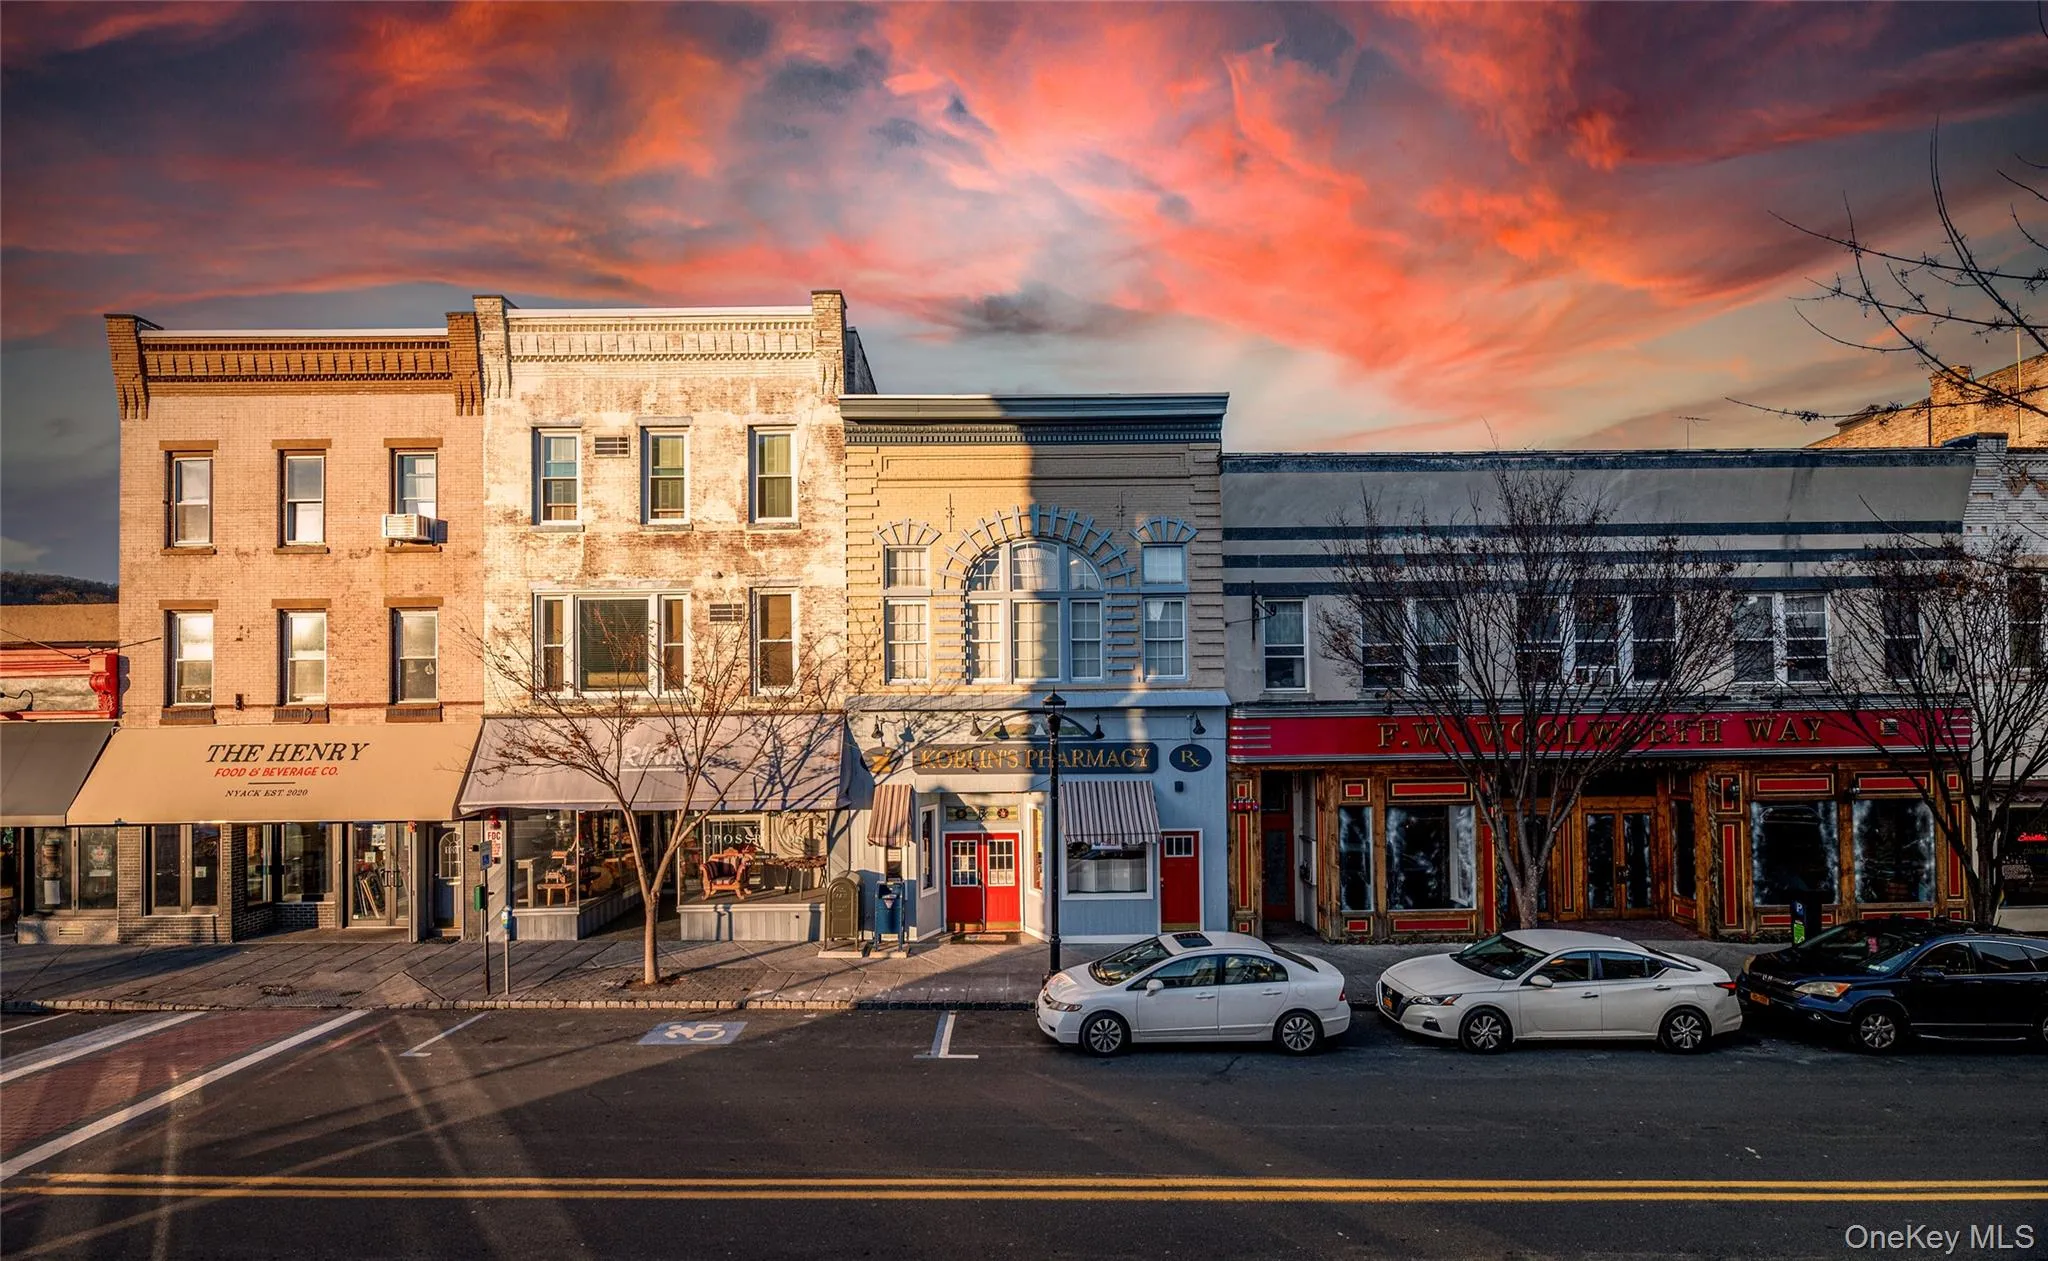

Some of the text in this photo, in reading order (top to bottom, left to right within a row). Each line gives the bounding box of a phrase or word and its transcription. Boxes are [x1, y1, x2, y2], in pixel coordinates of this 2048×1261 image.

[1744, 717, 1825, 743] WAY
[206, 742, 370, 763] THE HENRY
[919, 748, 1150, 769] KOBLIN'S PHARMACY
[214, 766, 339, 778] FOOD & BEVERAGE CO.
[224, 789, 262, 798] NYACK
[286, 789, 309, 797] 2020
[486, 831, 502, 841] FDC
